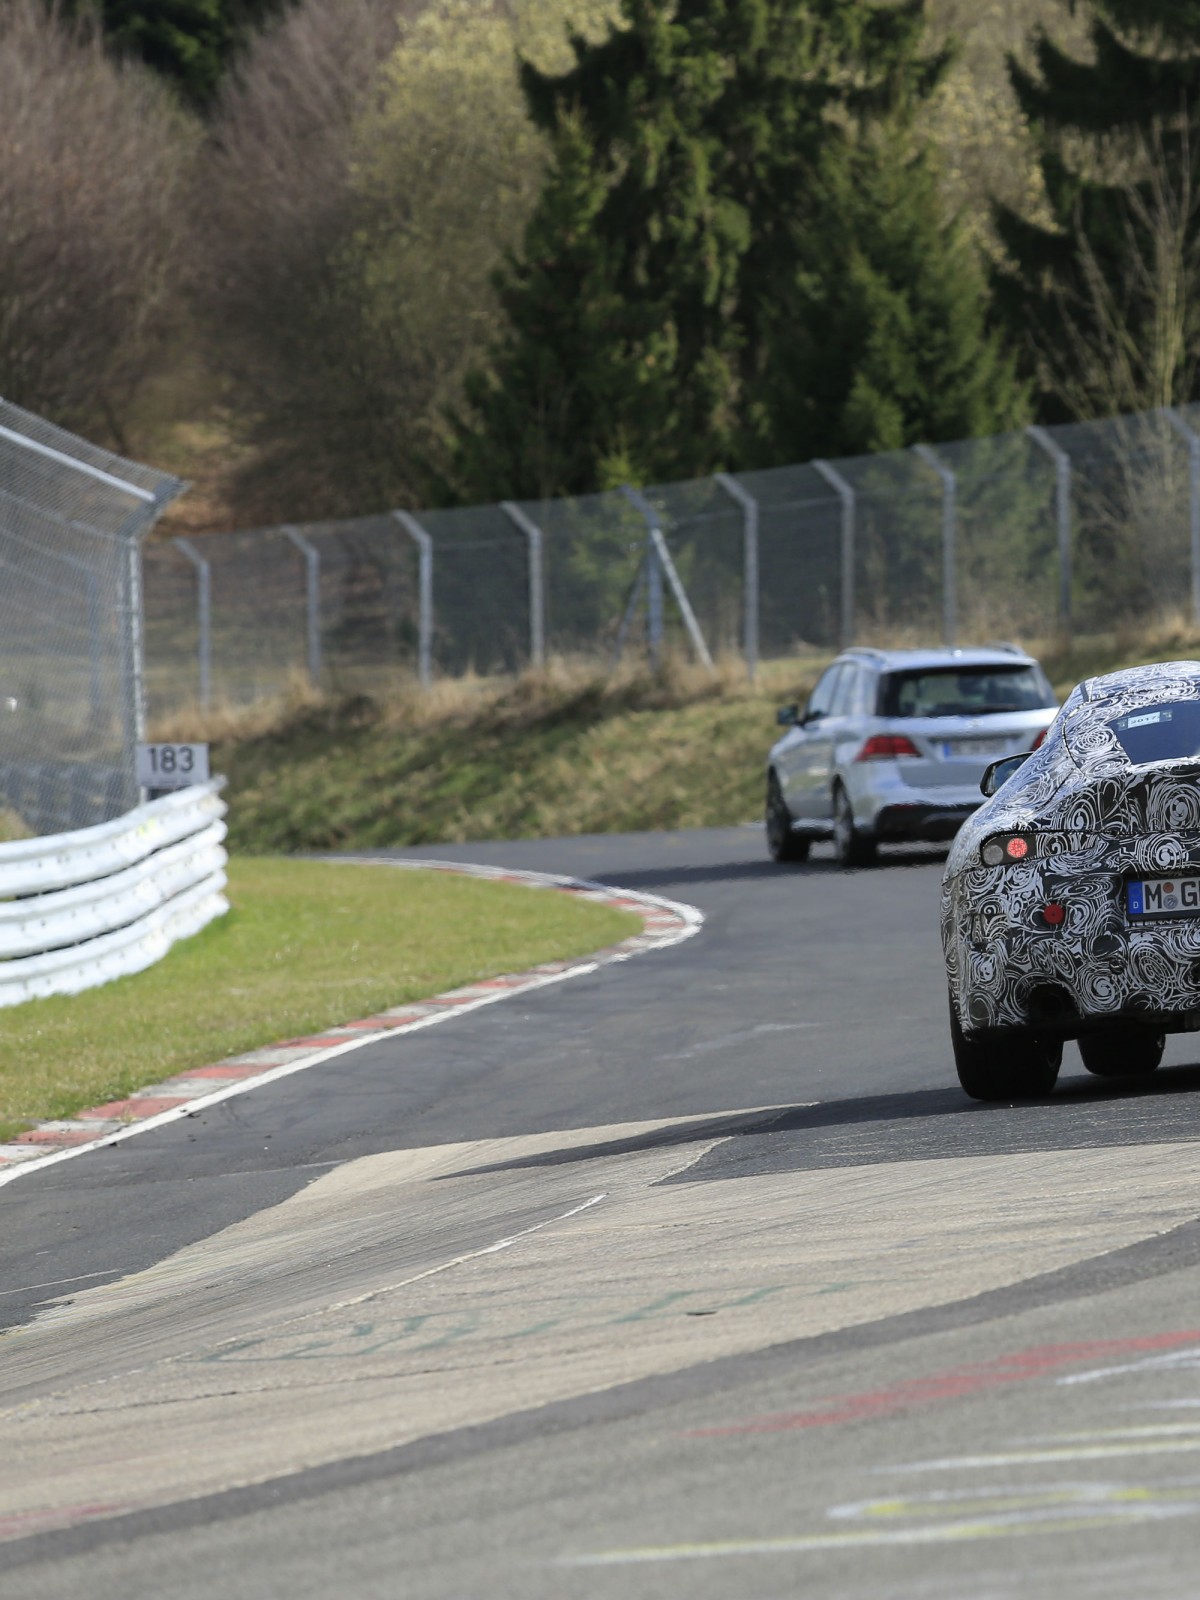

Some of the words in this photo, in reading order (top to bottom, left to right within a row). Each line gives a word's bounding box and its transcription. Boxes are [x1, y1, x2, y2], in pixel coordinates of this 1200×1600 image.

[147, 745, 194, 774] 183
[1132, 900, 1139, 909] D
[1144, 882, 1162, 910] M
